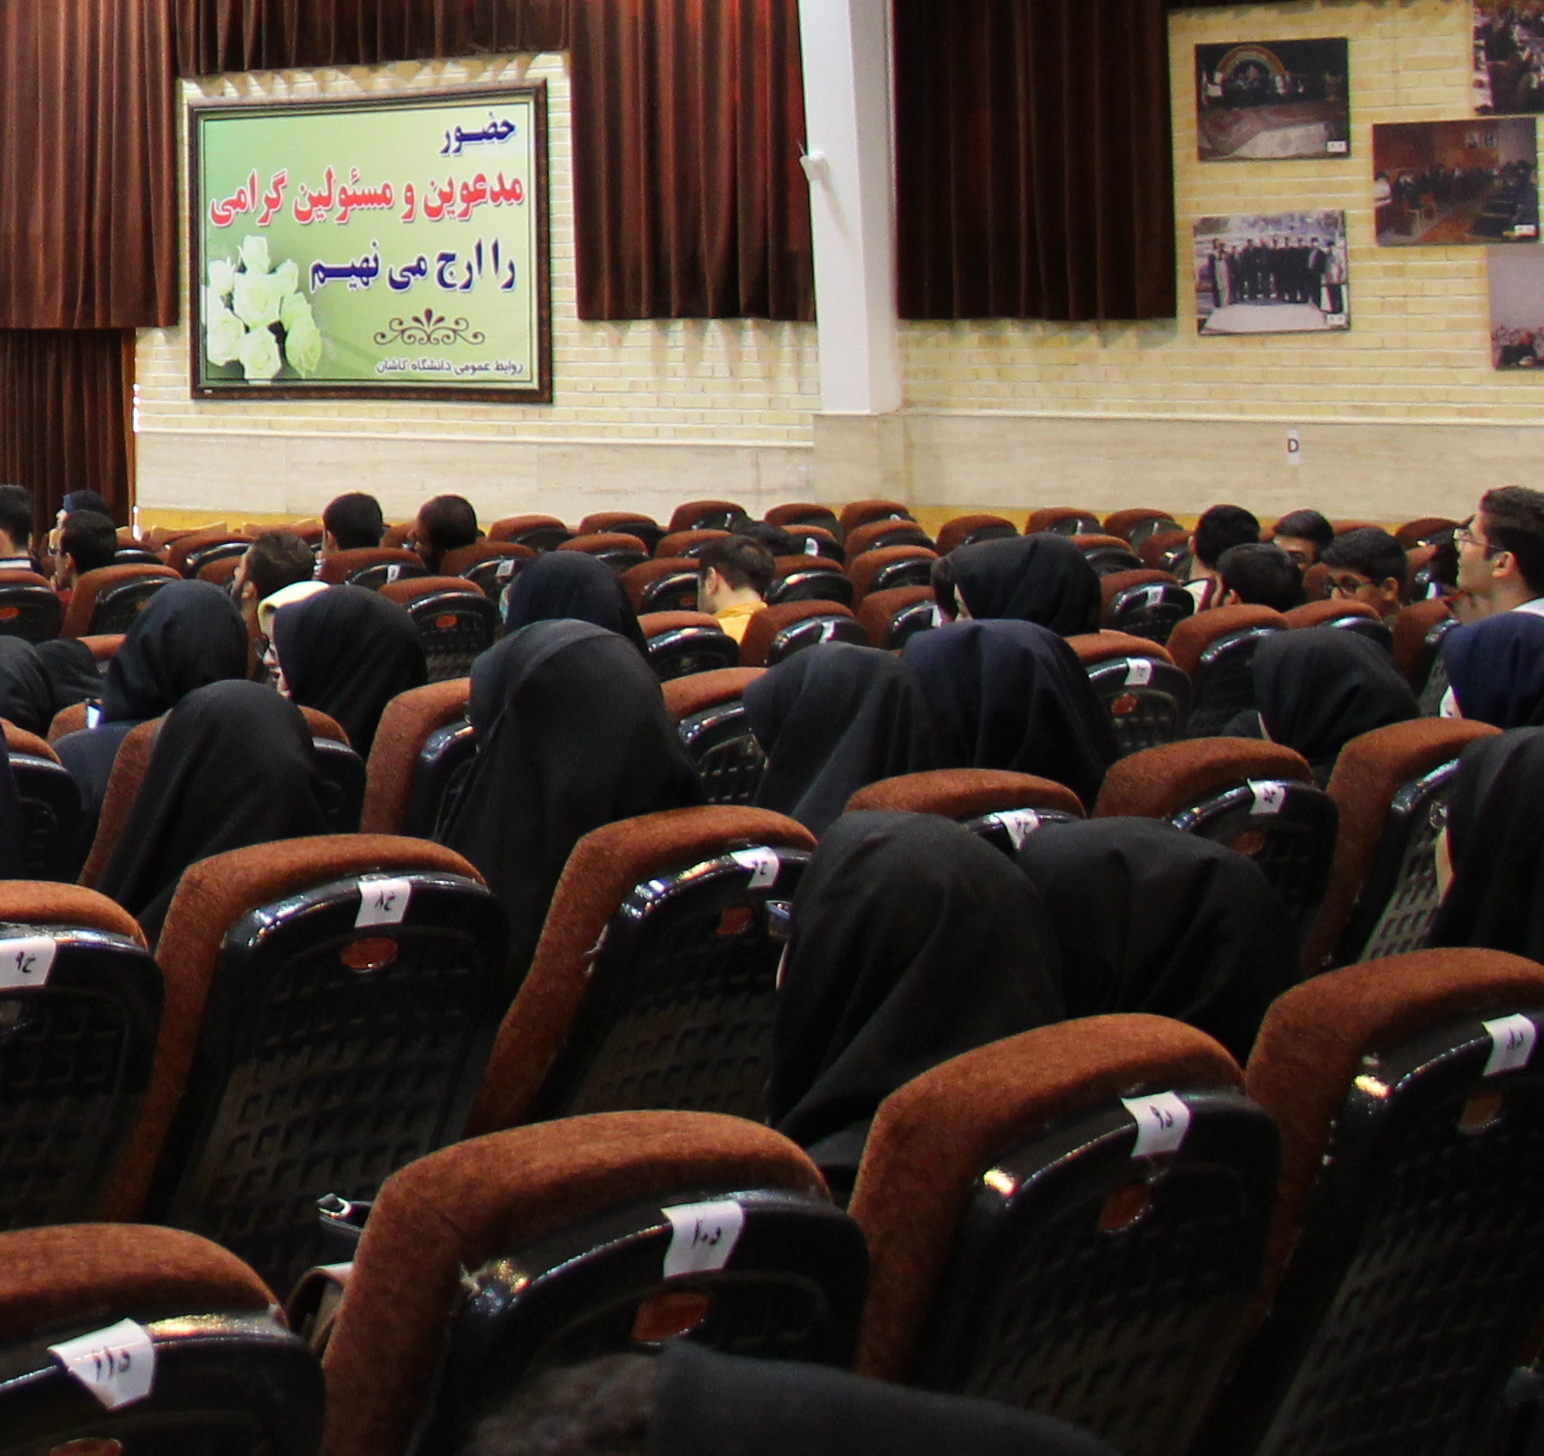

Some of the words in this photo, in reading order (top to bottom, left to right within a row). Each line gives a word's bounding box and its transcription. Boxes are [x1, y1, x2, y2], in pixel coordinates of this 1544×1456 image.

[437, 111, 517, 156] حضور
[210, 169, 289, 227] گرامی
[293, 166, 395, 226] مسئولین
[399, 181, 417, 222] و
[422, 171, 525, 222] مدعوین
[310, 240, 381, 294] نهیم
[387, 258, 428, 293] می
[435, 237, 484, 288] ارج
[491, 237, 516, 291] را
[376, 357, 409, 373] کاشان
[411, 357, 452, 372] دانشگاه
[454, 361, 492, 375] عمومی
[494, 358, 524, 376] روابط
